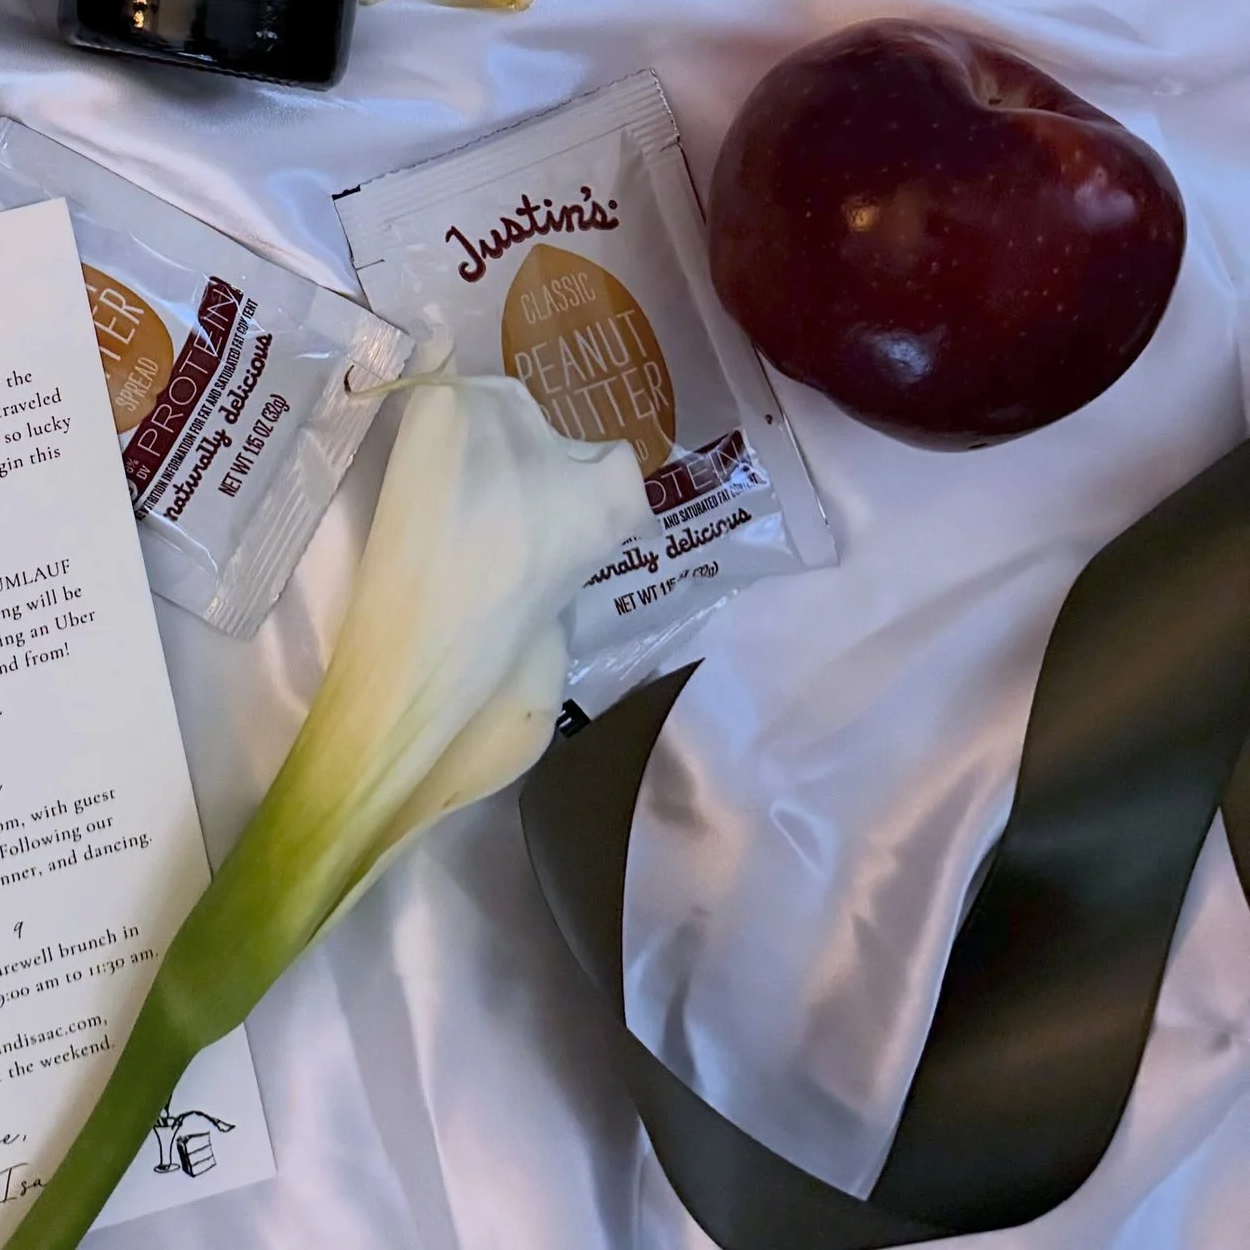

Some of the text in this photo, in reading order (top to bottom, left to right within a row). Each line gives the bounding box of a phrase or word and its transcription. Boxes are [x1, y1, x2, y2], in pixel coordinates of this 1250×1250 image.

[520, 272, 597, 325] CLASSIC
[514, 310, 647, 395] PEANUT
[5, 369, 33, 388] the
[115, 356, 160, 412] SPREAD
[138, 287, 238, 458] PROTEIN
[161, 431, 196, 482] INFORMATION
[189, 418, 204, 434] FOR
[197, 404, 211, 419] FAT
[205, 388, 221, 406] AND
[213, 348, 242, 389] SATURATED
[230, 334, 244, 348] FAT
[260, 393, 291, 425] (32g)
[544, 361, 670, 441] UTTER
[163, 332, 273, 522] naturally delicious
[252, 420, 272, 438] OZ
[137, 465, 150, 479] DV
[231, 451, 255, 476] WT
[219, 472, 243, 497] NET
[664, 513, 680, 530] AND
[681, 495, 719, 522] SATURATED
[614, 585, 658, 616] NET WT
[30, 799, 68, 822] with
[73, 789, 115, 815] guest
[85, 816, 114, 834] our
[47, 848, 78, 872] and
[83, 833, 153, 861] dancing.
[13, 920, 24, 940] 9
[8, 1060, 34, 1079] the
[39, 1033, 115, 1069] weekend.
